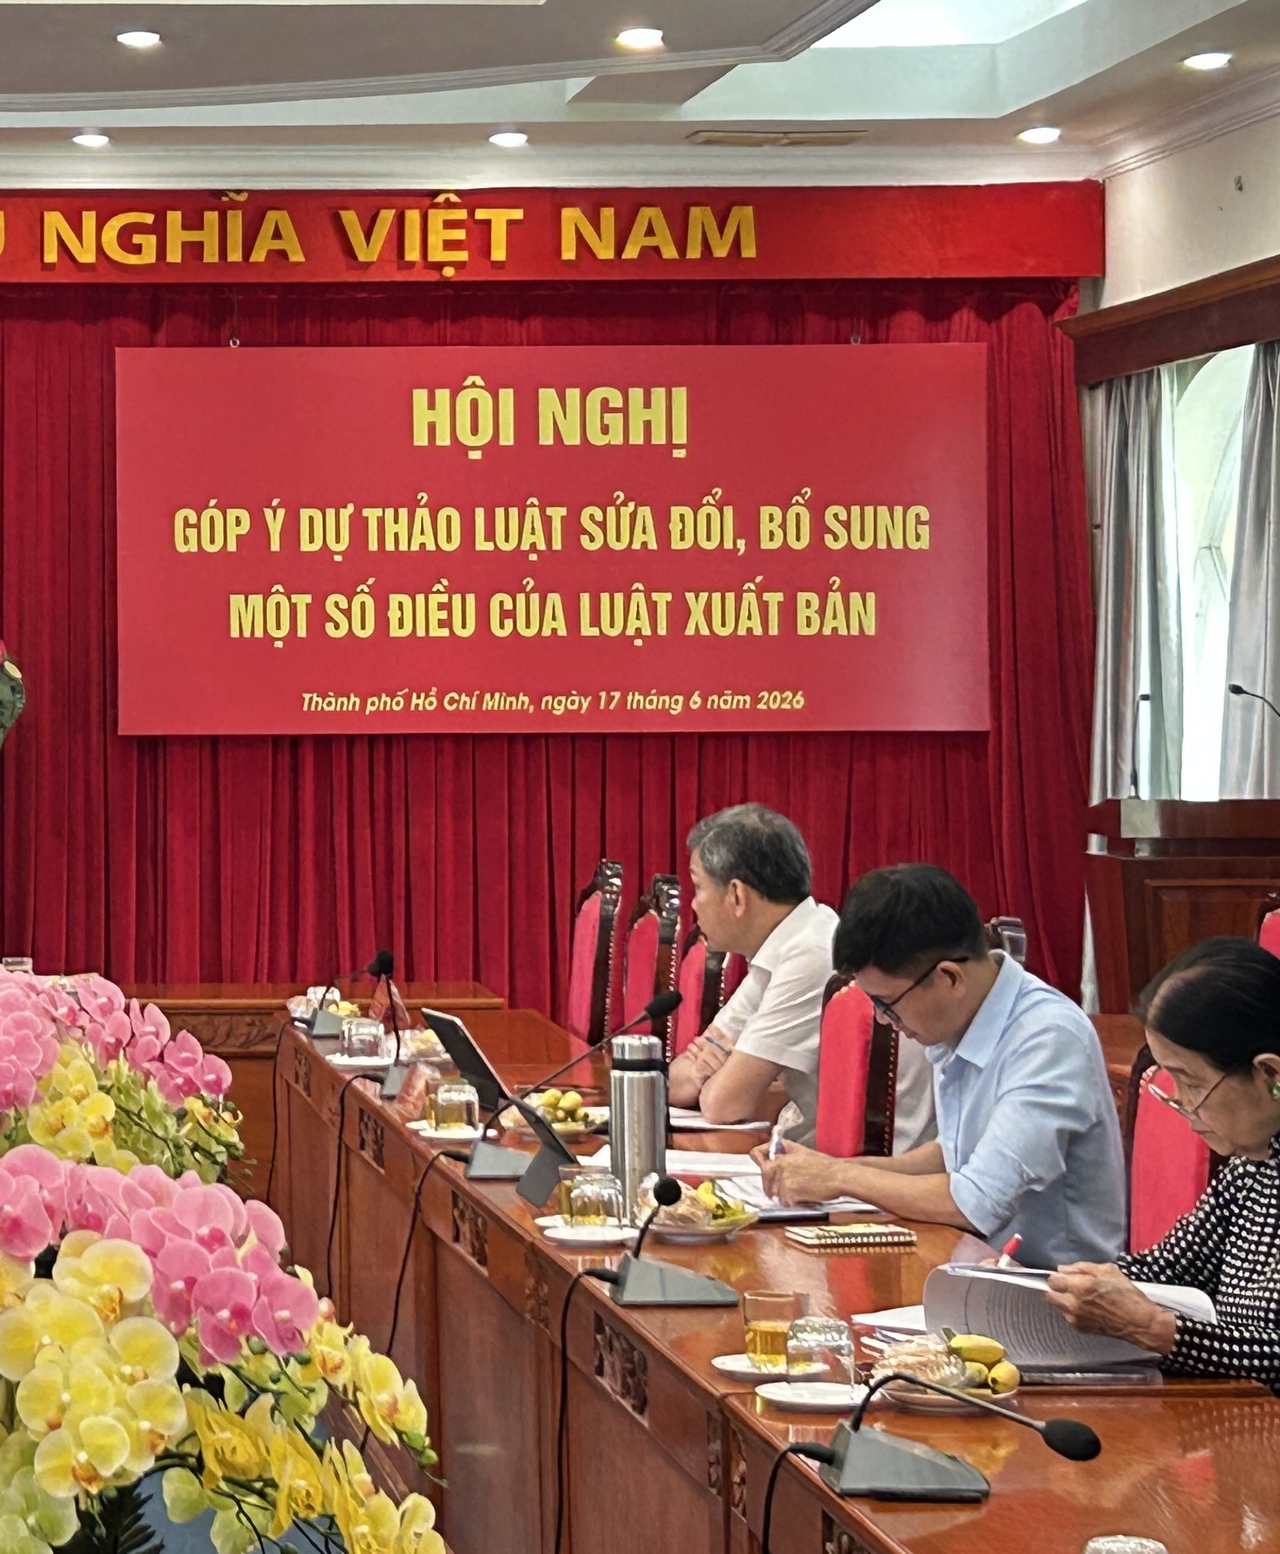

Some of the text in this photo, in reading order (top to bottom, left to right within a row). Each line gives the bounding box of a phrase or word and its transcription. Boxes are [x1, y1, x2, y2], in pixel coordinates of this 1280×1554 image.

[42, 190, 306, 264] NGHĨA
[338, 192, 525, 278] VIỆT
[560, 205, 758, 261] NAM
[412, 375, 688, 460] HỘI NGHỊ
[174, 487, 931, 563] GÓP Ý DỰ THẢO LUẬT SỬA ĐỔI, BỔ SUNG
[229, 575, 876, 649] MỘT SỐ ĐIỀU CỦA LUẬT XUẤT BẢN
[302, 691, 361, 712] Thành
[365, 688, 409, 715] phố
[443, 690, 481, 711] Chí
[482, 691, 535, 714] Minh,
[540, 690, 593, 716] ngày
[598, 691, 622, 710] 17
[626, 688, 685, 716] tháng
[688, 690, 702, 710] 6
[706, 690, 751, 710] năm
[756, 690, 805, 710] 2026
